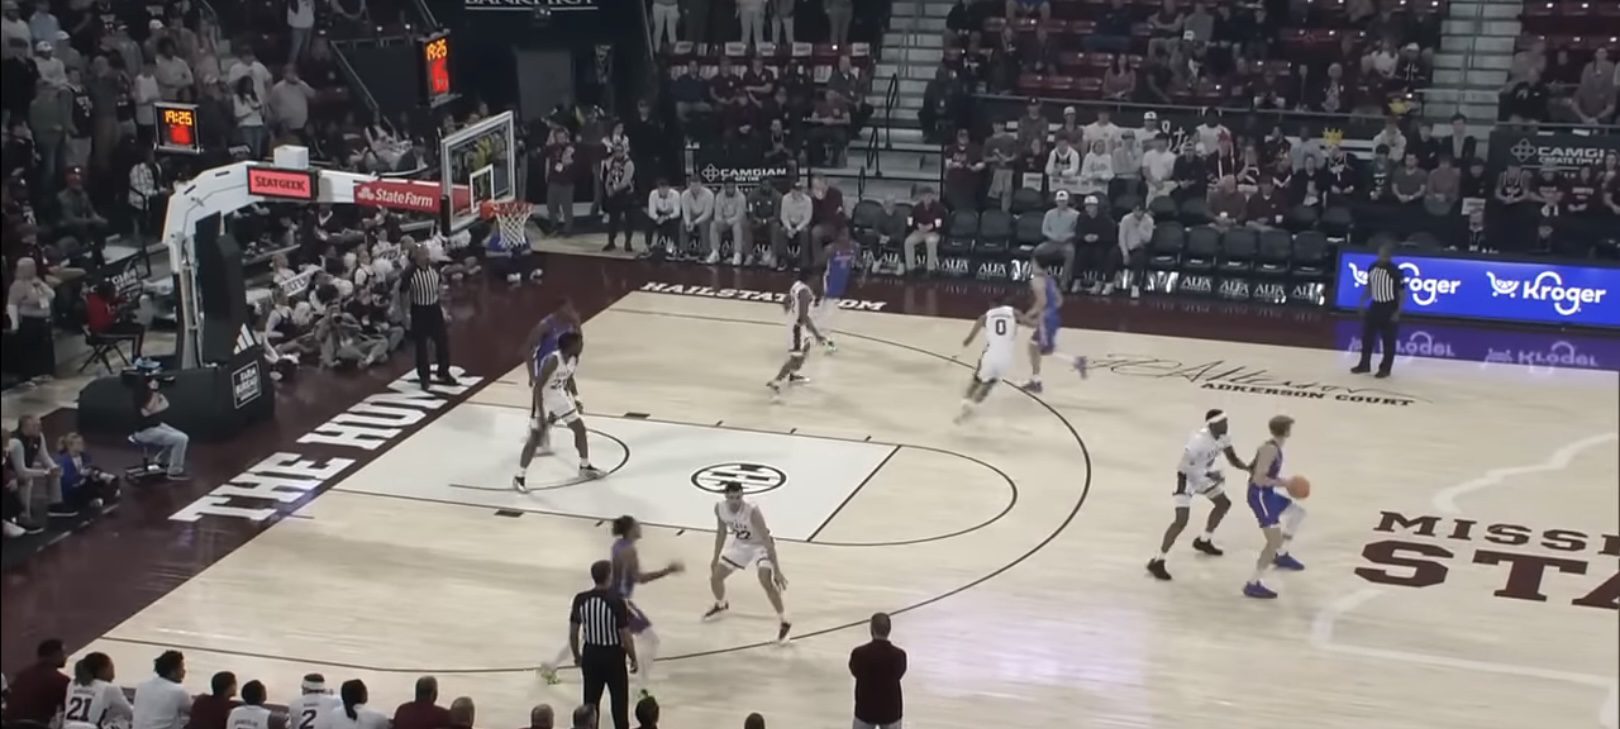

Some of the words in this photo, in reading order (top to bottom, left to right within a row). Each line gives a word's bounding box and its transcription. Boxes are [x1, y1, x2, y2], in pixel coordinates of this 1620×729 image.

[164, 110, 193, 126] 19:25
[1537, 146, 1605, 158] CAMGI
[254, 175, 306, 191] SEATGEEK
[1523, 271, 1606, 315] Kroger
[996, 319, 1006, 335] 0
[1201, 383, 1324, 400] ADKERSON
[1335, 394, 1415, 407] COURT
[168, 452, 356, 522] THE
[66, 696, 92, 722] 21
[299, 709, 318, 729] 2
